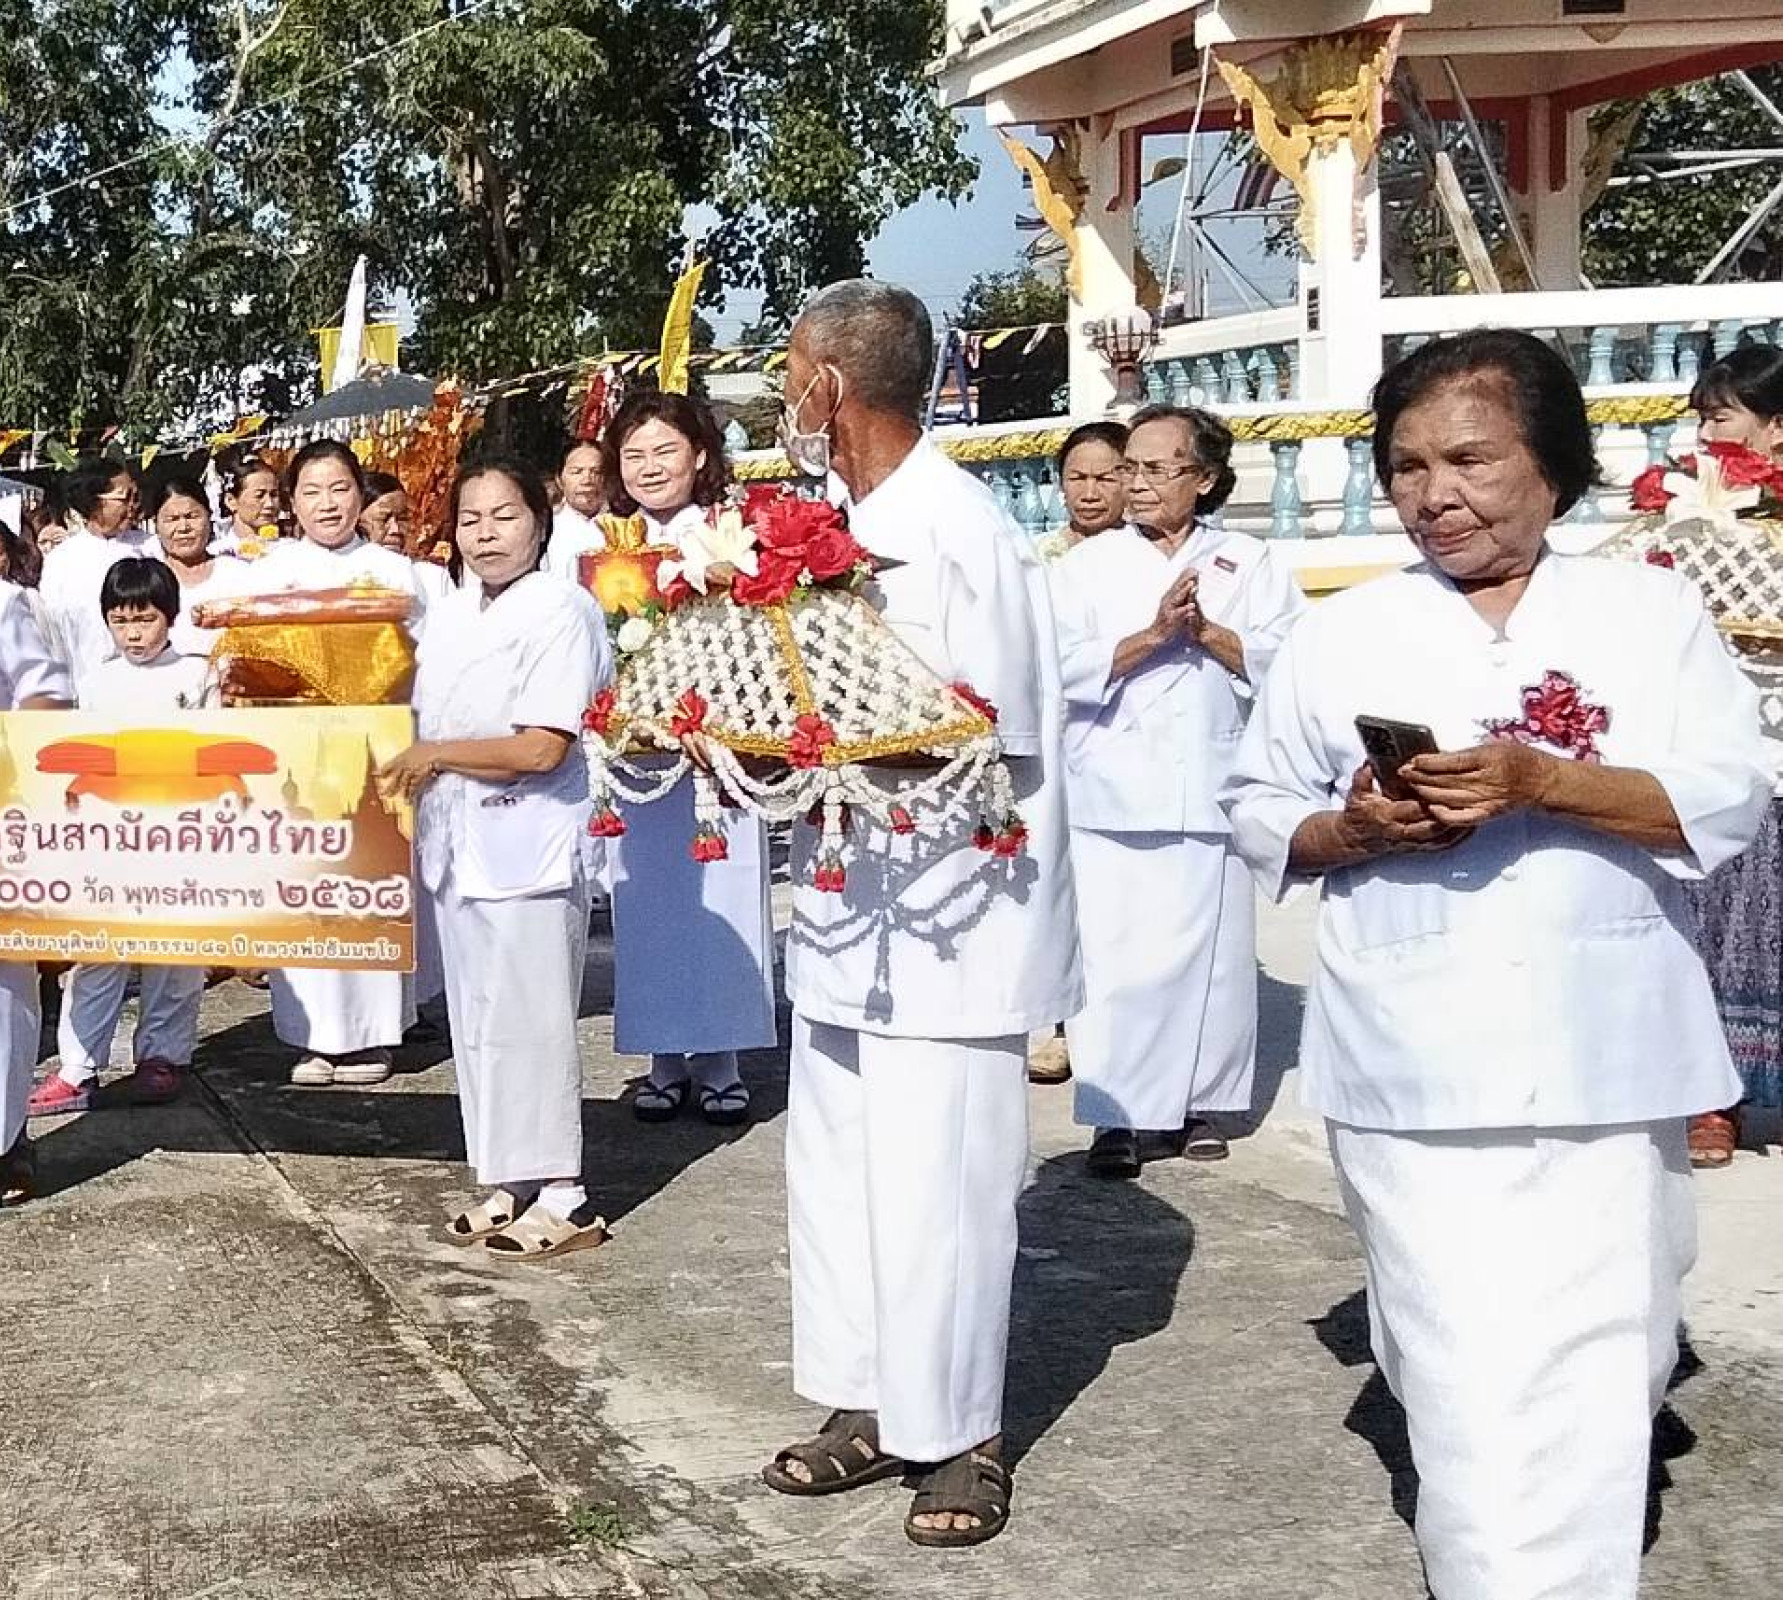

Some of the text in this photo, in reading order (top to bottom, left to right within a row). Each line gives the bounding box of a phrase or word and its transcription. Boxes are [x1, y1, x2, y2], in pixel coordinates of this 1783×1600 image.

[82, 874, 114, 903] วัด
[122, 879, 265, 915] พุทธศักราช
[276, 878, 404, 910] ๒๕๖๘
[233, 933, 248, 954] ปี
